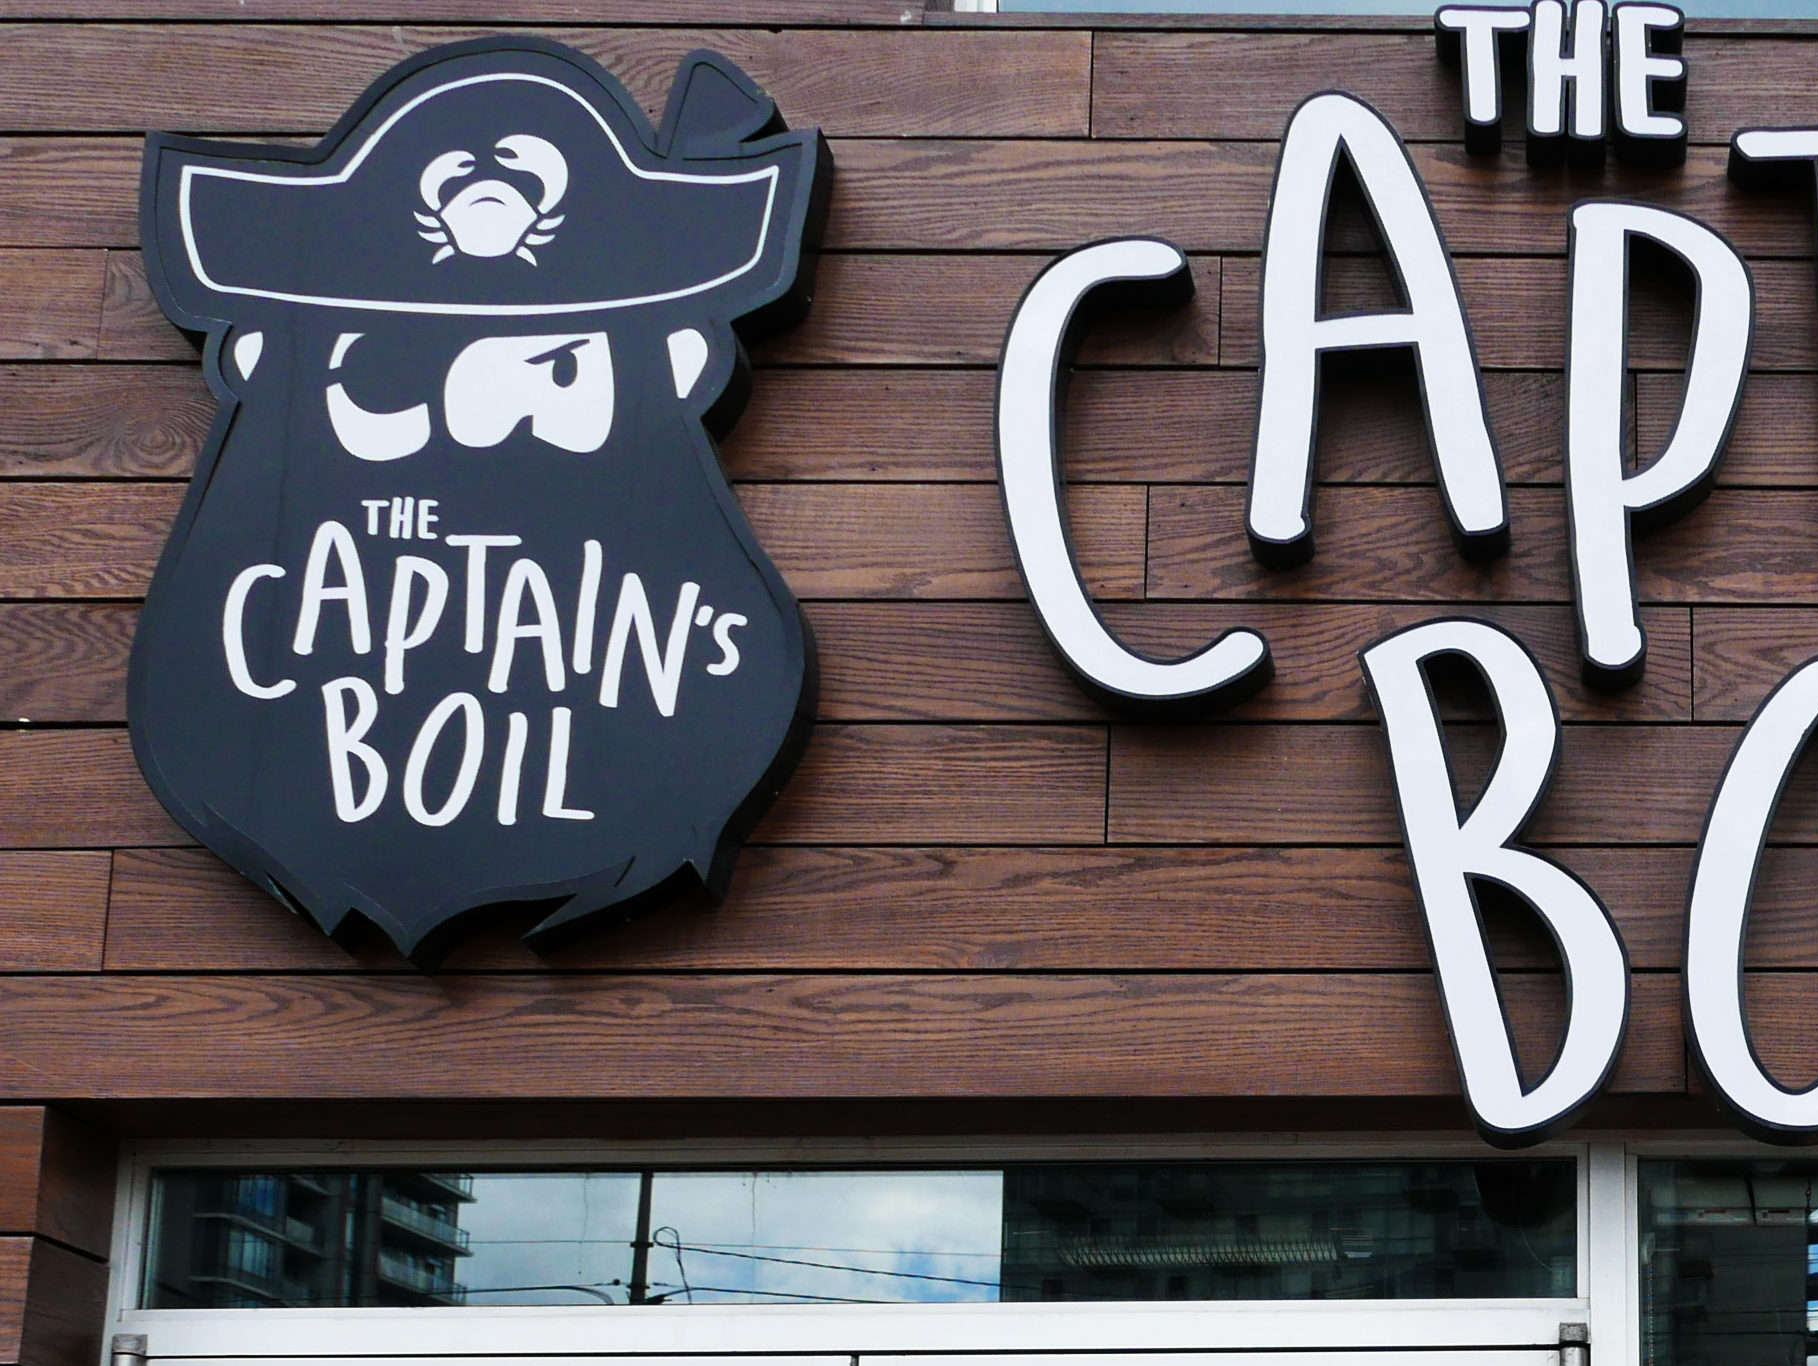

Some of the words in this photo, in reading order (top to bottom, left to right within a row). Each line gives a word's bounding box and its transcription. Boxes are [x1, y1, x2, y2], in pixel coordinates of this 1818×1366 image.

[1436, 0, 1688, 140] THE
[362, 497, 438, 540] THE
[321, 676, 595, 826] BOIL
